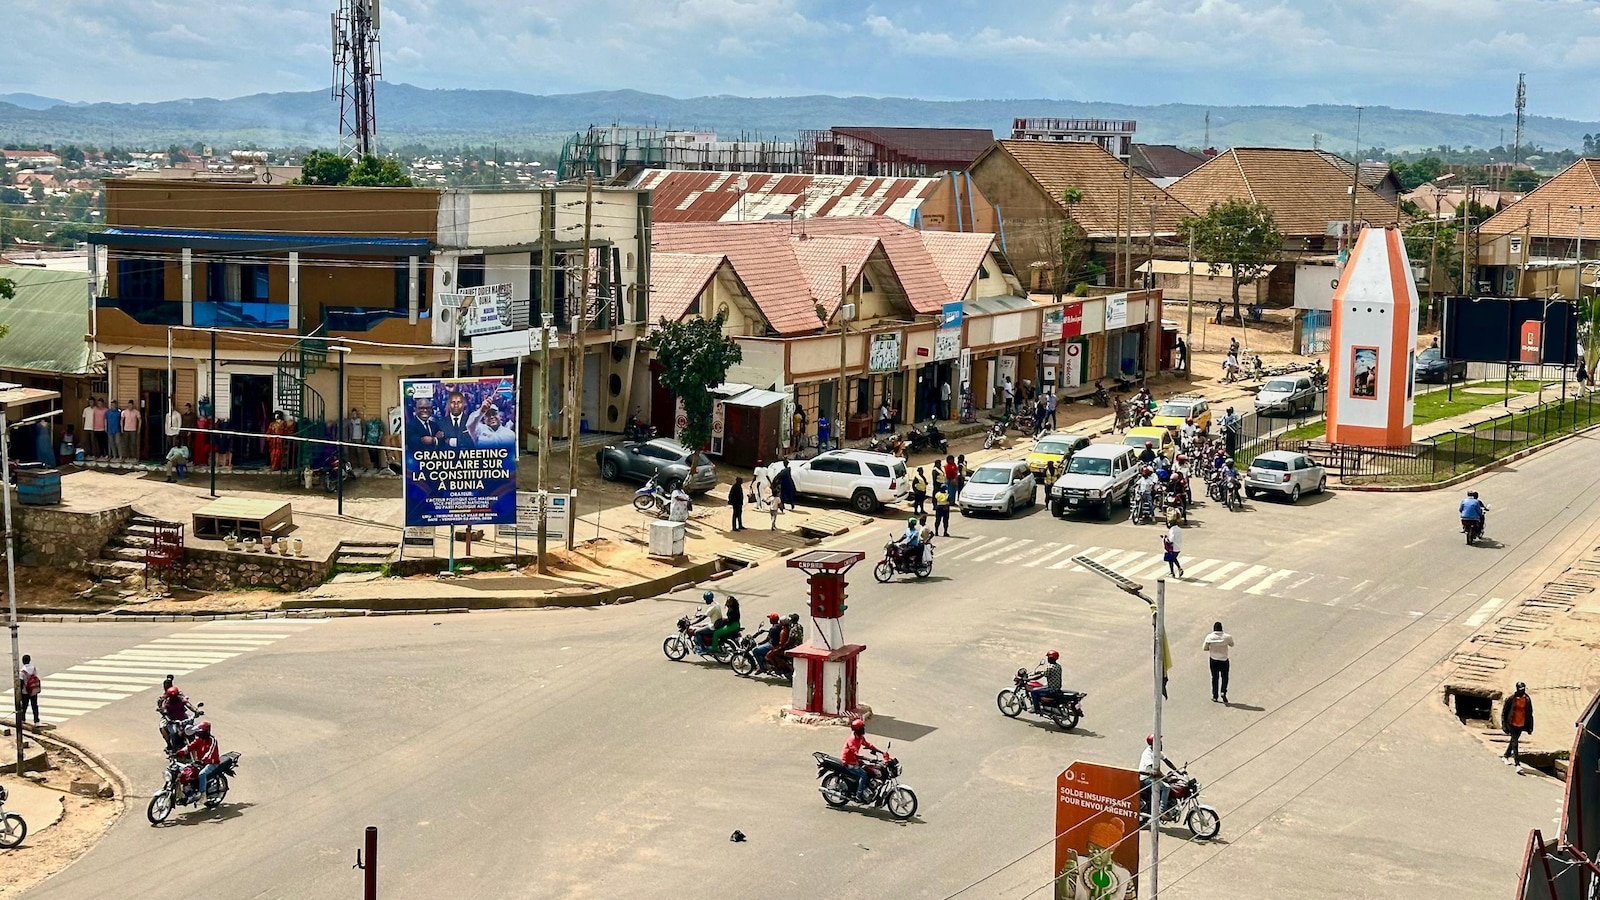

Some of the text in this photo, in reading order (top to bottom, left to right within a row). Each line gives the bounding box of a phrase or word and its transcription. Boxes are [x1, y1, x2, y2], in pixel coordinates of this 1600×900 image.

[413, 449, 508, 460] GRAND MEETING
[419, 459, 503, 471] POPULAIRE SUR
[412, 469, 510, 481] LA CONSTITUTION
[449, 480, 485, 491] BUNIA
[1060, 786, 1132, 809] SOLDE INSUFFISANT
[1060, 795, 1080, 806] POUR
[1080, 800, 1103, 811] ENVOI
[1102, 805, 1133, 818] ARGENT
